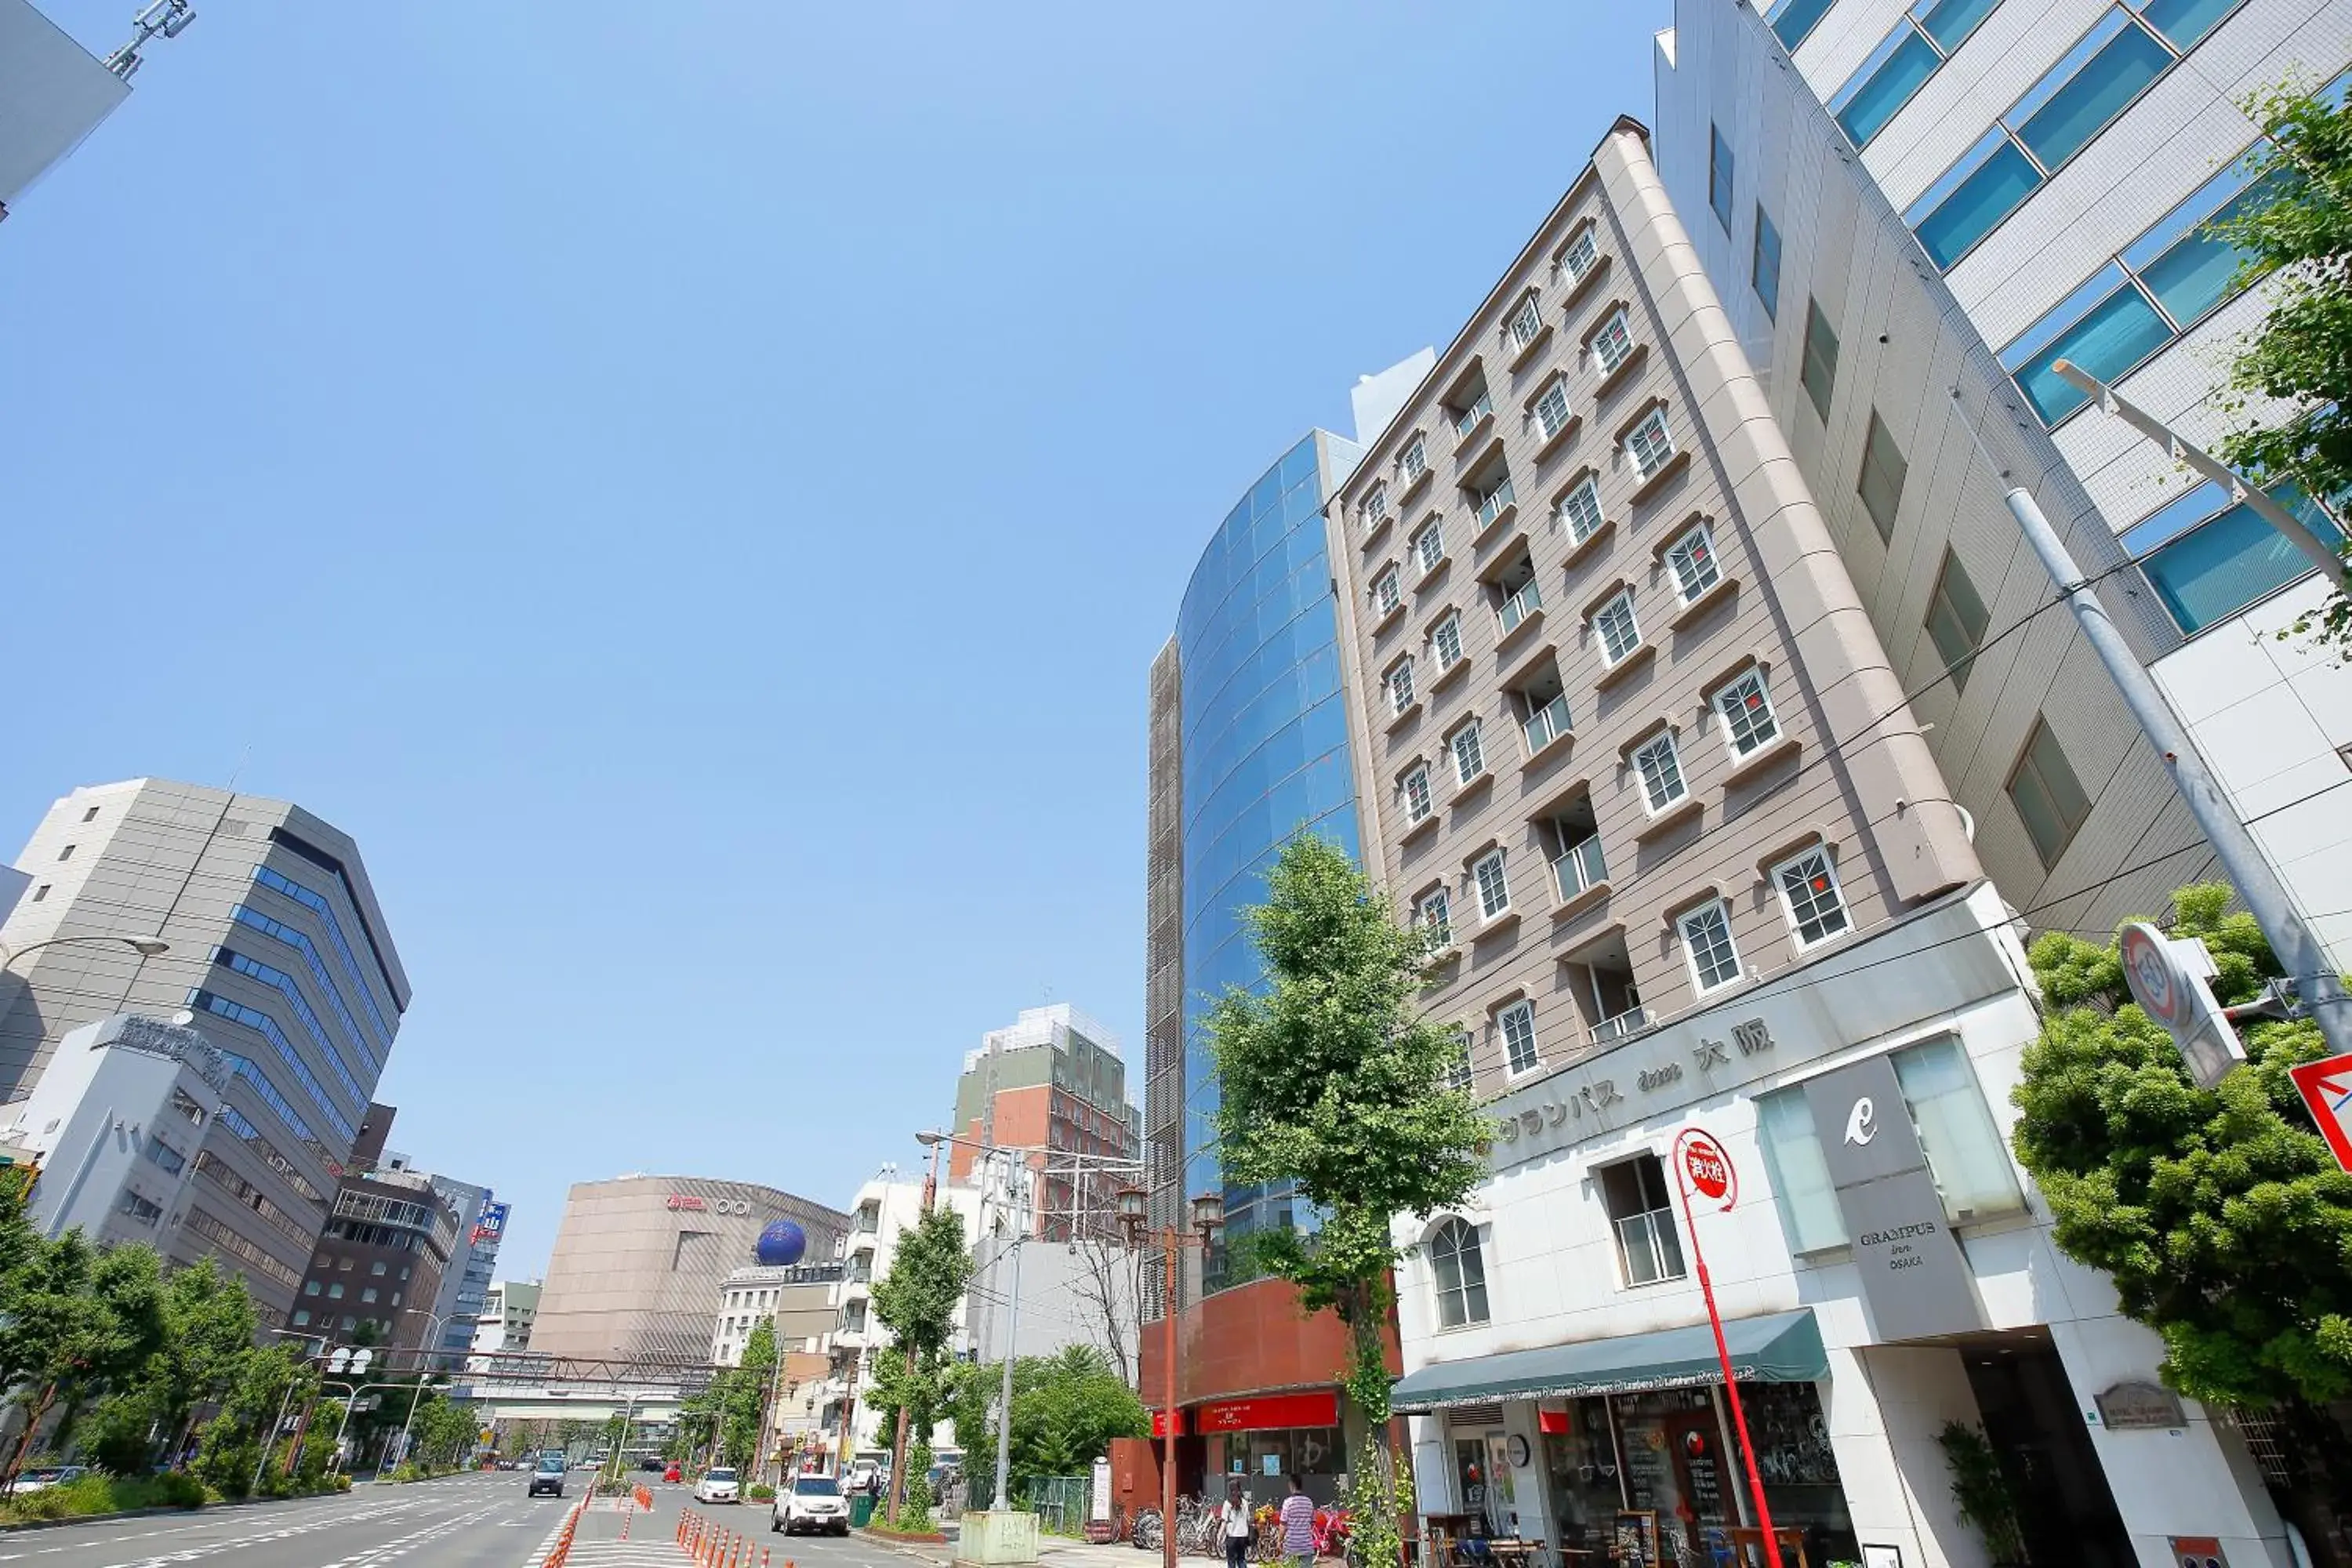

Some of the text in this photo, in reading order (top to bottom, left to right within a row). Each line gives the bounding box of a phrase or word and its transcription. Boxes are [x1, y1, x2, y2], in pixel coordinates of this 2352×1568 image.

[1692, 1018, 1776, 1071] 大阪
[1688, 1156, 1726, 1183] 消火栓
[1860, 1221, 1936, 1246] GRAMPUS
[1890, 1255, 1923, 1270] OSAKA
